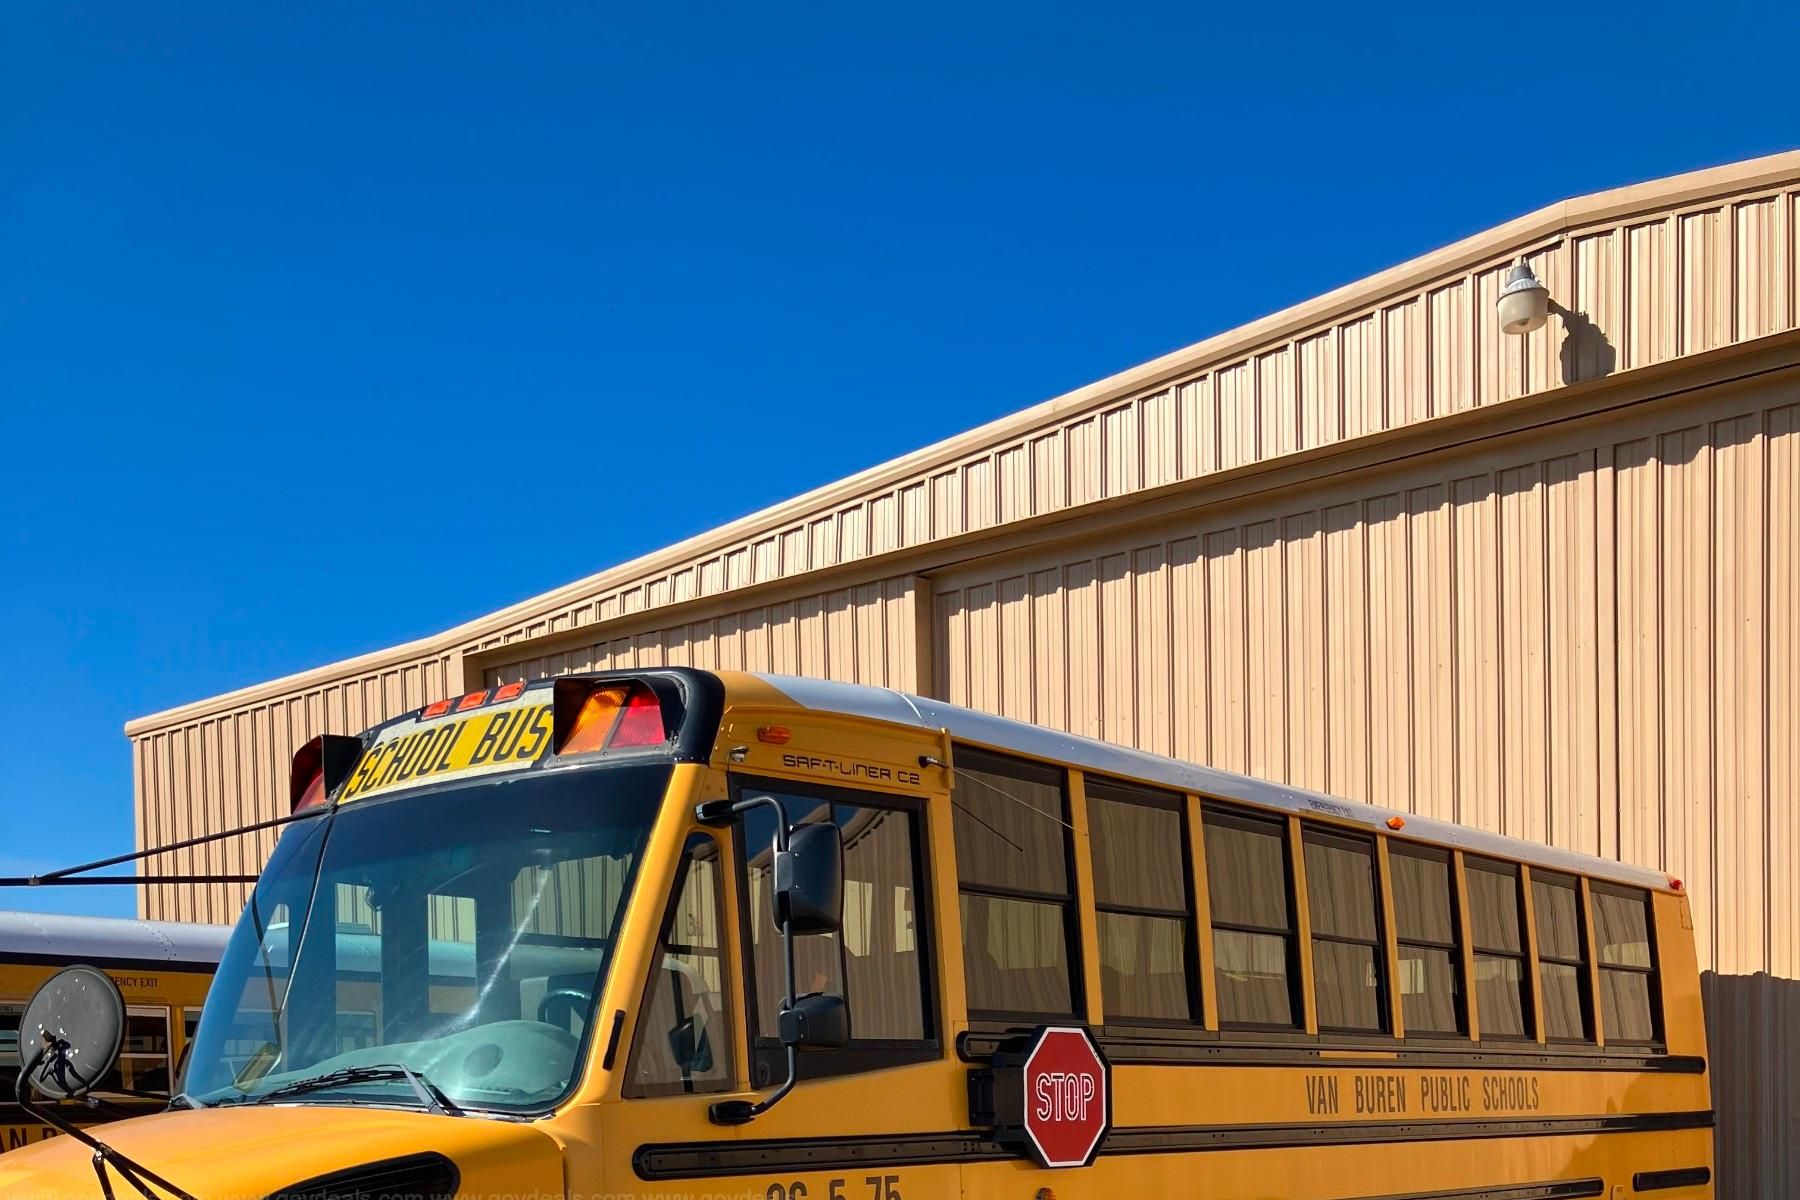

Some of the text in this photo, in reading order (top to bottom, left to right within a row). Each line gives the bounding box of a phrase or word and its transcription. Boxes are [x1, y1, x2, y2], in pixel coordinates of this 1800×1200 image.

[347, 705, 553, 798] SCHOOL BUS
[783, 754, 921, 786] SAF-T-LINER C2
[140, 977, 158, 988] EXIT
[1036, 1072, 1095, 1122] STOP
[1306, 1075, 1539, 1115] VAN BUREN PUBLIC SCHOOLS
